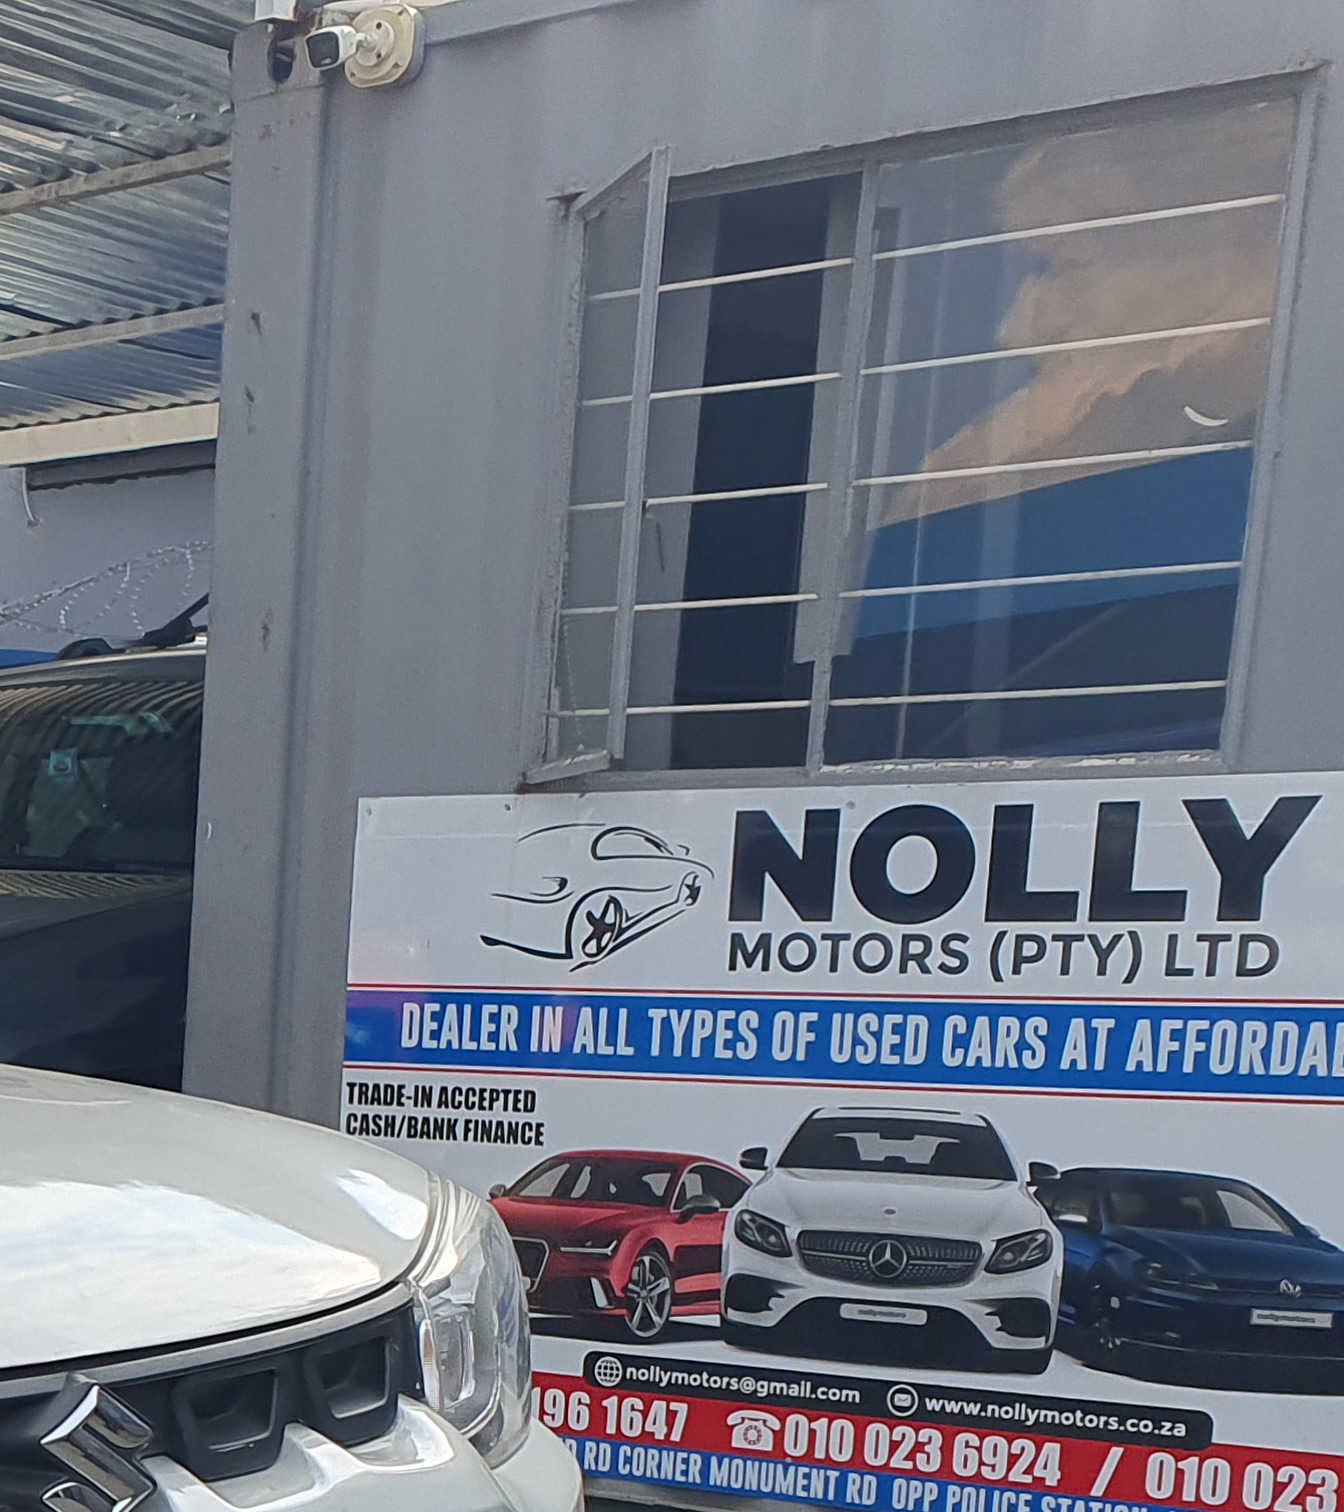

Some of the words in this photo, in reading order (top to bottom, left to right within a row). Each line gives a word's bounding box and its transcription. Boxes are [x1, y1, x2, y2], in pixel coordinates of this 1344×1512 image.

[728, 795, 1323, 925] NOLLY
[728, 932, 971, 976] MOTORS
[989, 929, 1143, 985] (PTY)
[1164, 932, 1280, 979] LTD
[400, 1002, 519, 1052] DEALER
[530, 1004, 563, 1054] IN
[572, 1006, 635, 1056] ALL
[648, 1008, 759, 1060] TYPES
[772, 1010, 817, 1063] OF
[830, 1011, 929, 1066] USED
[942, 1014, 1050, 1070] CARS
[1059, 1017, 1116, 1072] AT
[345, 1081, 431, 1108] TRADE-IN
[437, 1085, 537, 1114] ACCEPTED
[345, 1112, 459, 1142] CASH/BANK
[462, 1118, 545, 1147] FINANCE
[625, 1365, 862, 1405] nollymotors@gmail.com
[601, 1394, 689, 1443] 1647
[924, 1398, 1187, 1439] www.nollymotors.co.za
[583, 1440, 611, 1473] RD
[617, 1444, 703, 1485] CORNER
[709, 1455, 840, 1502] MONUMENT
[845, 1473, 877, 1507] RD
[783, 1413, 855, 1463] 010
[863, 1422, 943, 1474] 023
[952, 1431, 1062, 1487] 6924
[1090, 1446, 1125, 1497] /
[1144, 1451, 1231, 1506] 010
